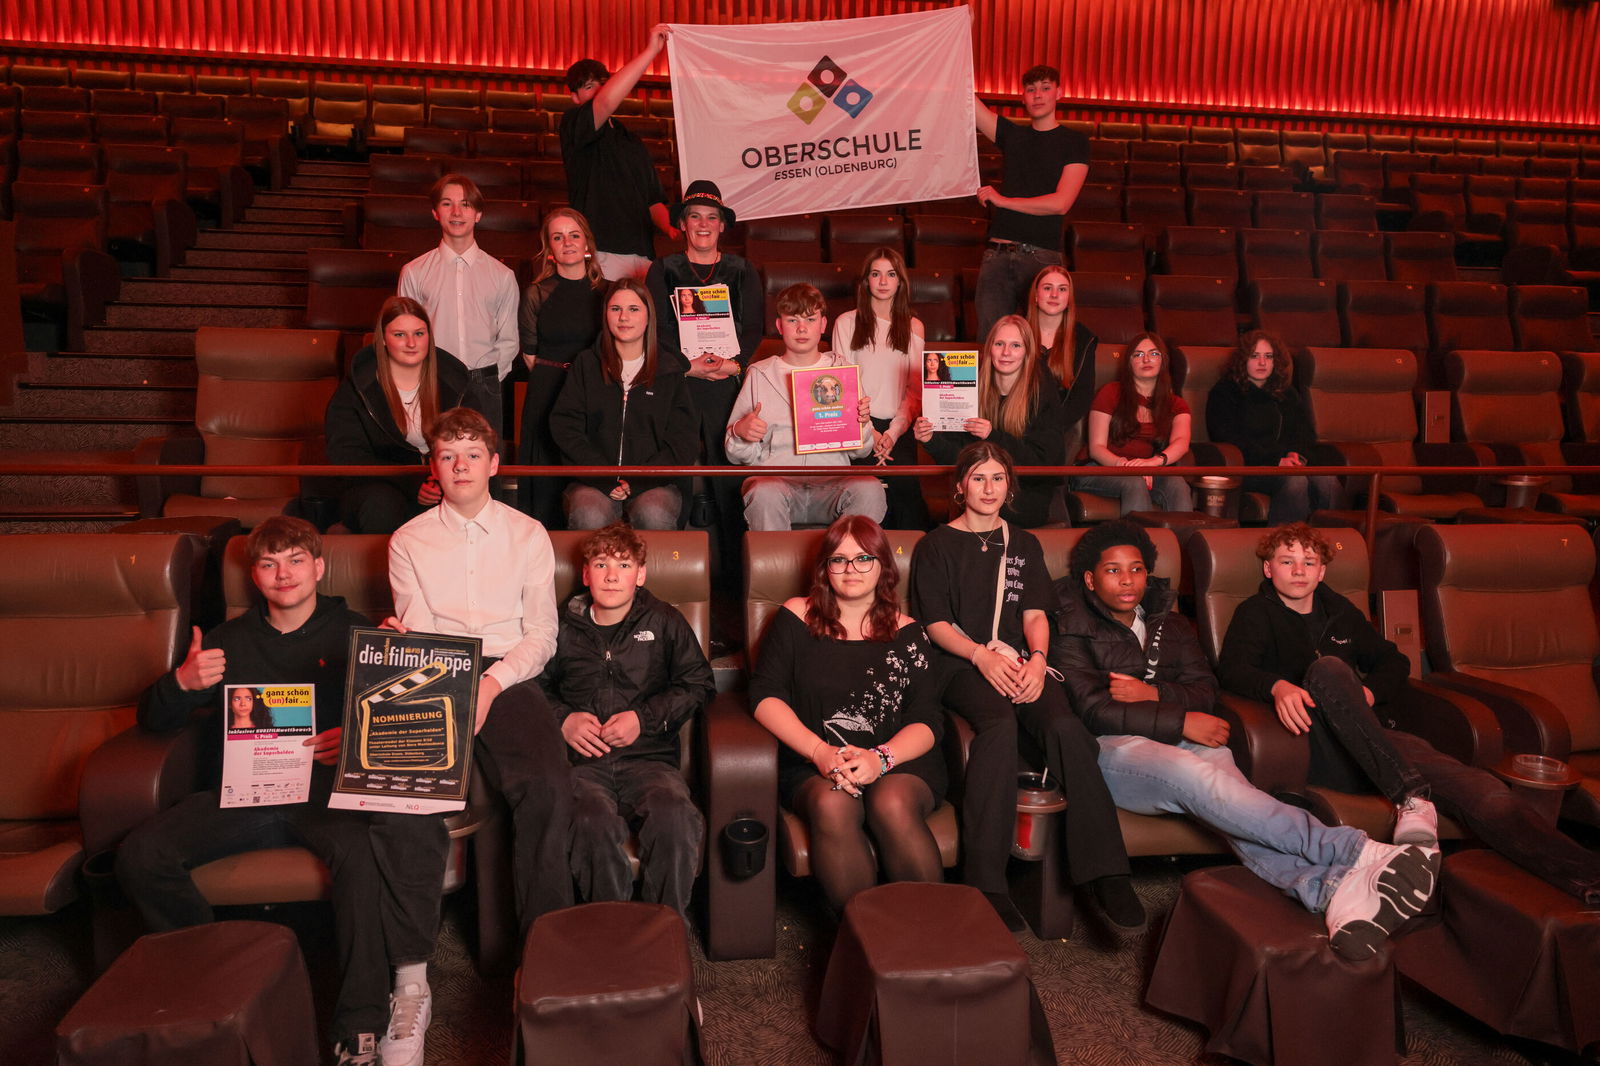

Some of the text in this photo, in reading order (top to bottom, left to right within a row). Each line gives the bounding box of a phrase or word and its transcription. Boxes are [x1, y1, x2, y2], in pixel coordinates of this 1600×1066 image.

[741, 129, 922, 169] OBERSCHULE
[774, 158, 897, 180] ESSEN (OLDENBURG)
[896, 545, 903, 554] 4
[1336, 542, 1343, 550] 6
[672, 551, 679, 560] 3
[359, 644, 383, 665] die
[388, 646, 472, 677] filmklappe
[372, 711, 443, 723] NOMINIERUNG
